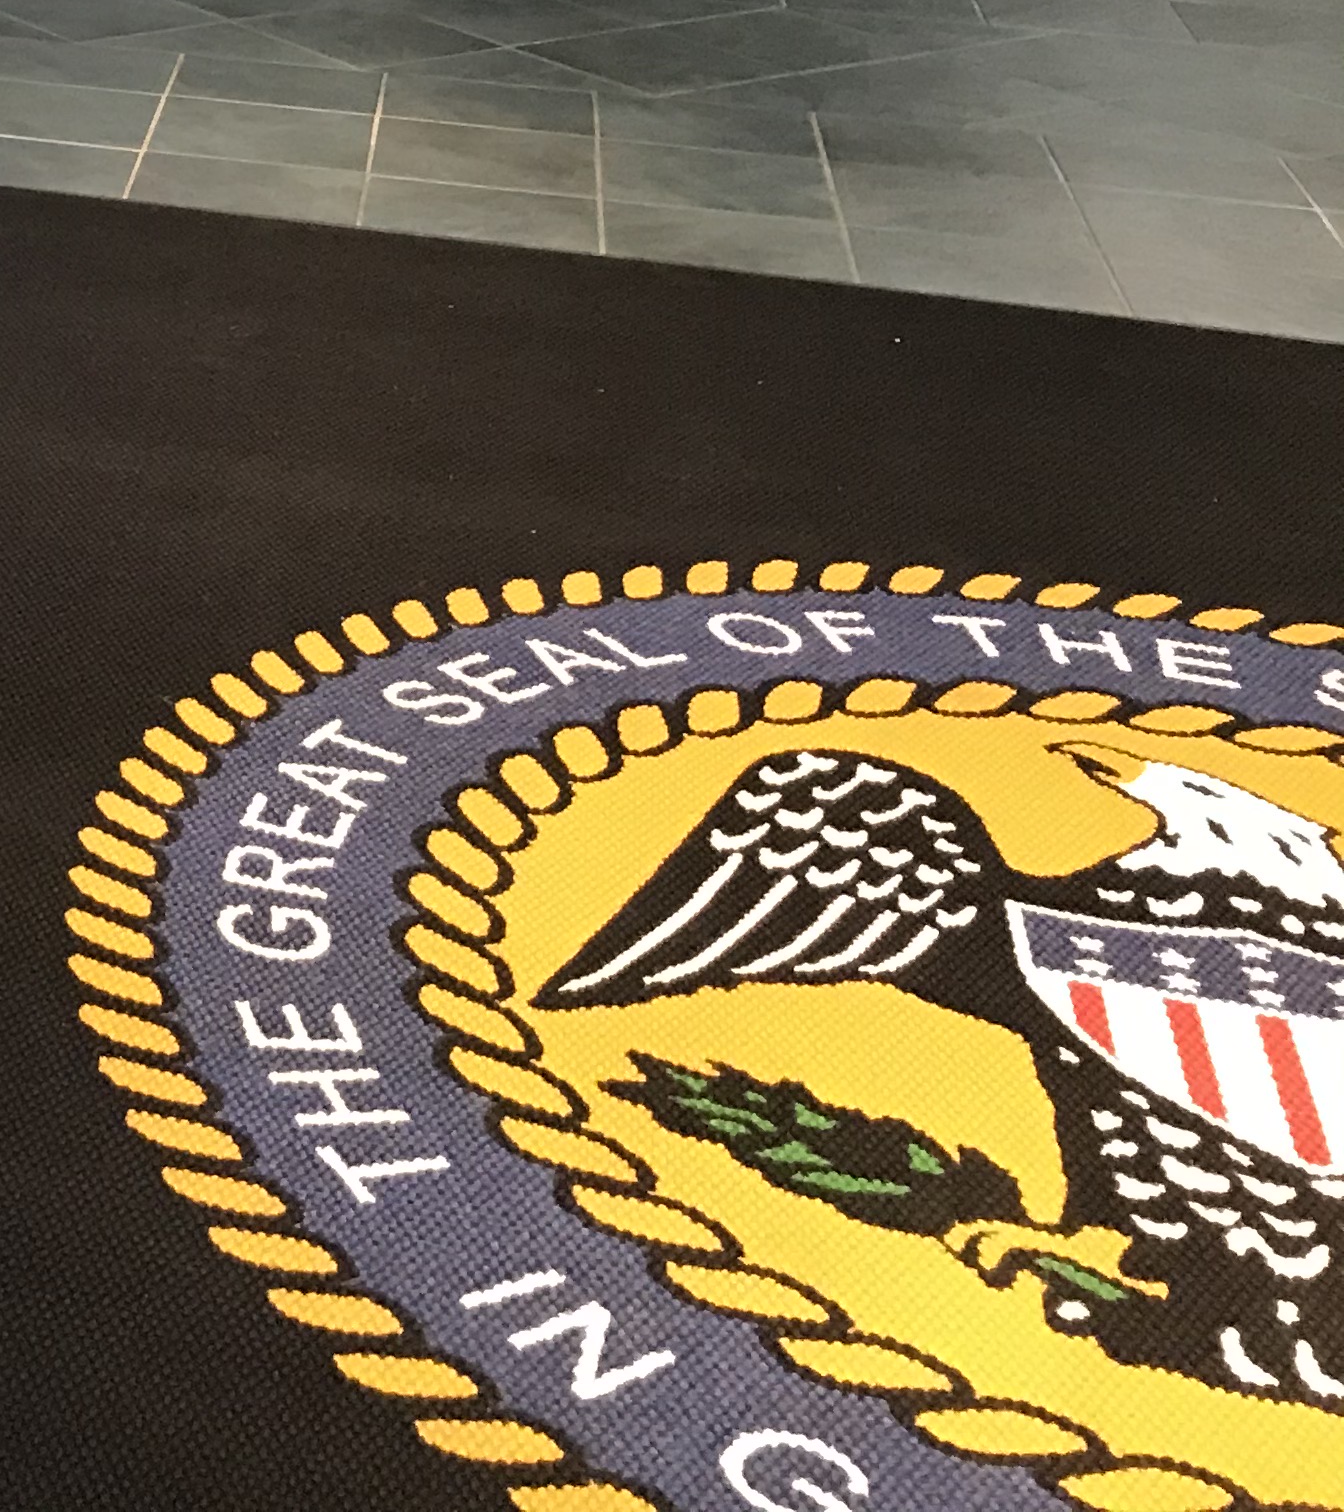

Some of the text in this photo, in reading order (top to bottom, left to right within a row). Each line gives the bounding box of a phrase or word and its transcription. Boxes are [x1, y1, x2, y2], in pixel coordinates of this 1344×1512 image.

[382, 627, 689, 727] SEAL
[706, 609, 876, 657] OF
[930, 613, 1243, 690] THE
[216, 718, 408, 962] GREAT
[233, 999, 451, 1204] THE
[458, 1268, 677, 1401] IN
